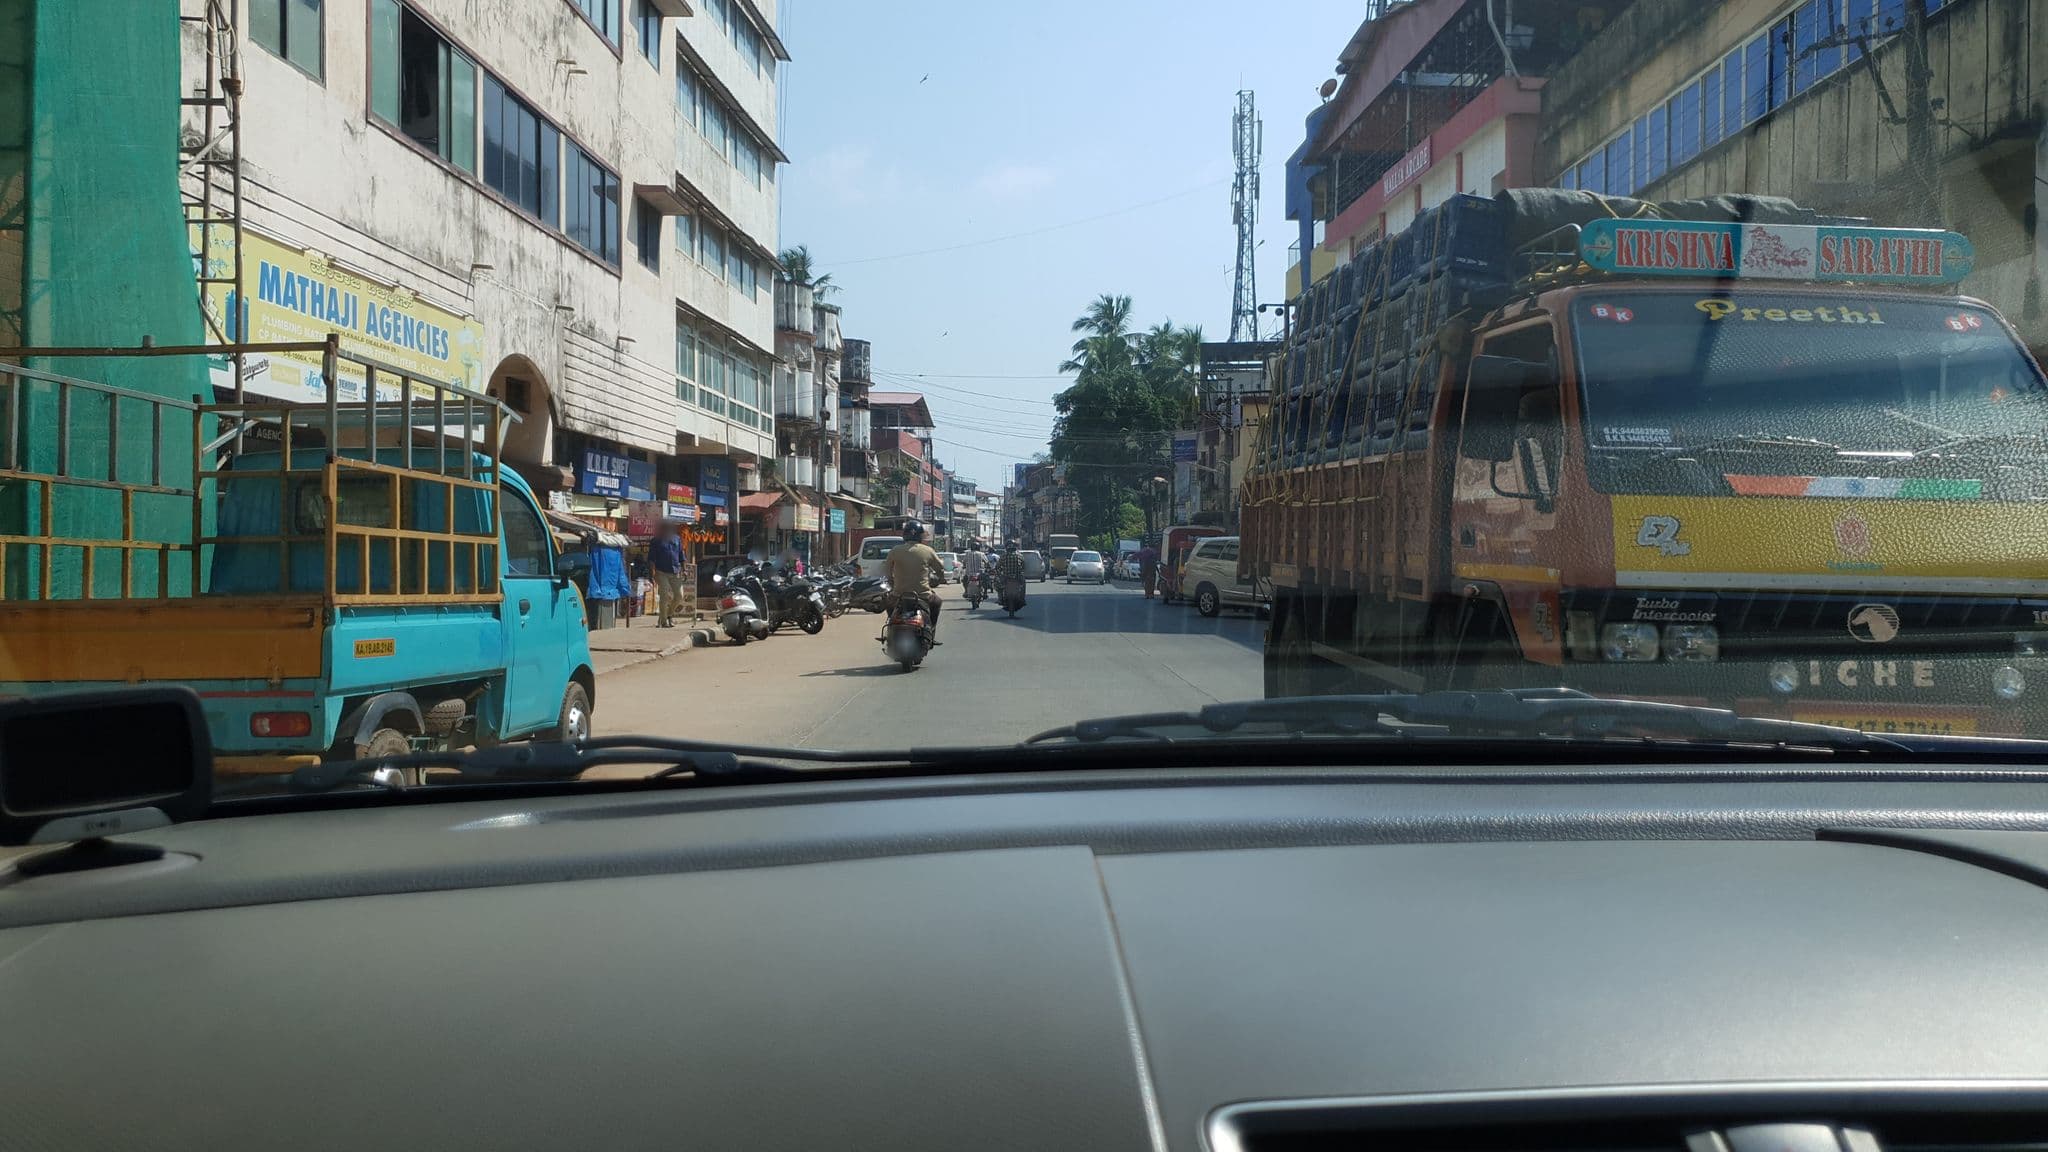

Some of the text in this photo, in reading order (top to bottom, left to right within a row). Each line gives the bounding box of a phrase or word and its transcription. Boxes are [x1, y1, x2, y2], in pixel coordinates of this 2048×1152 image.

[1615, 229, 1944, 278] KRISHNA SARATHI
[258, 260, 450, 362] MATHAJI AGENCIES
[1694, 299, 1886, 325] Preethi
[1632, 609, 1716, 621] Intercooler
[1636, 597, 1680, 609] Turbo
